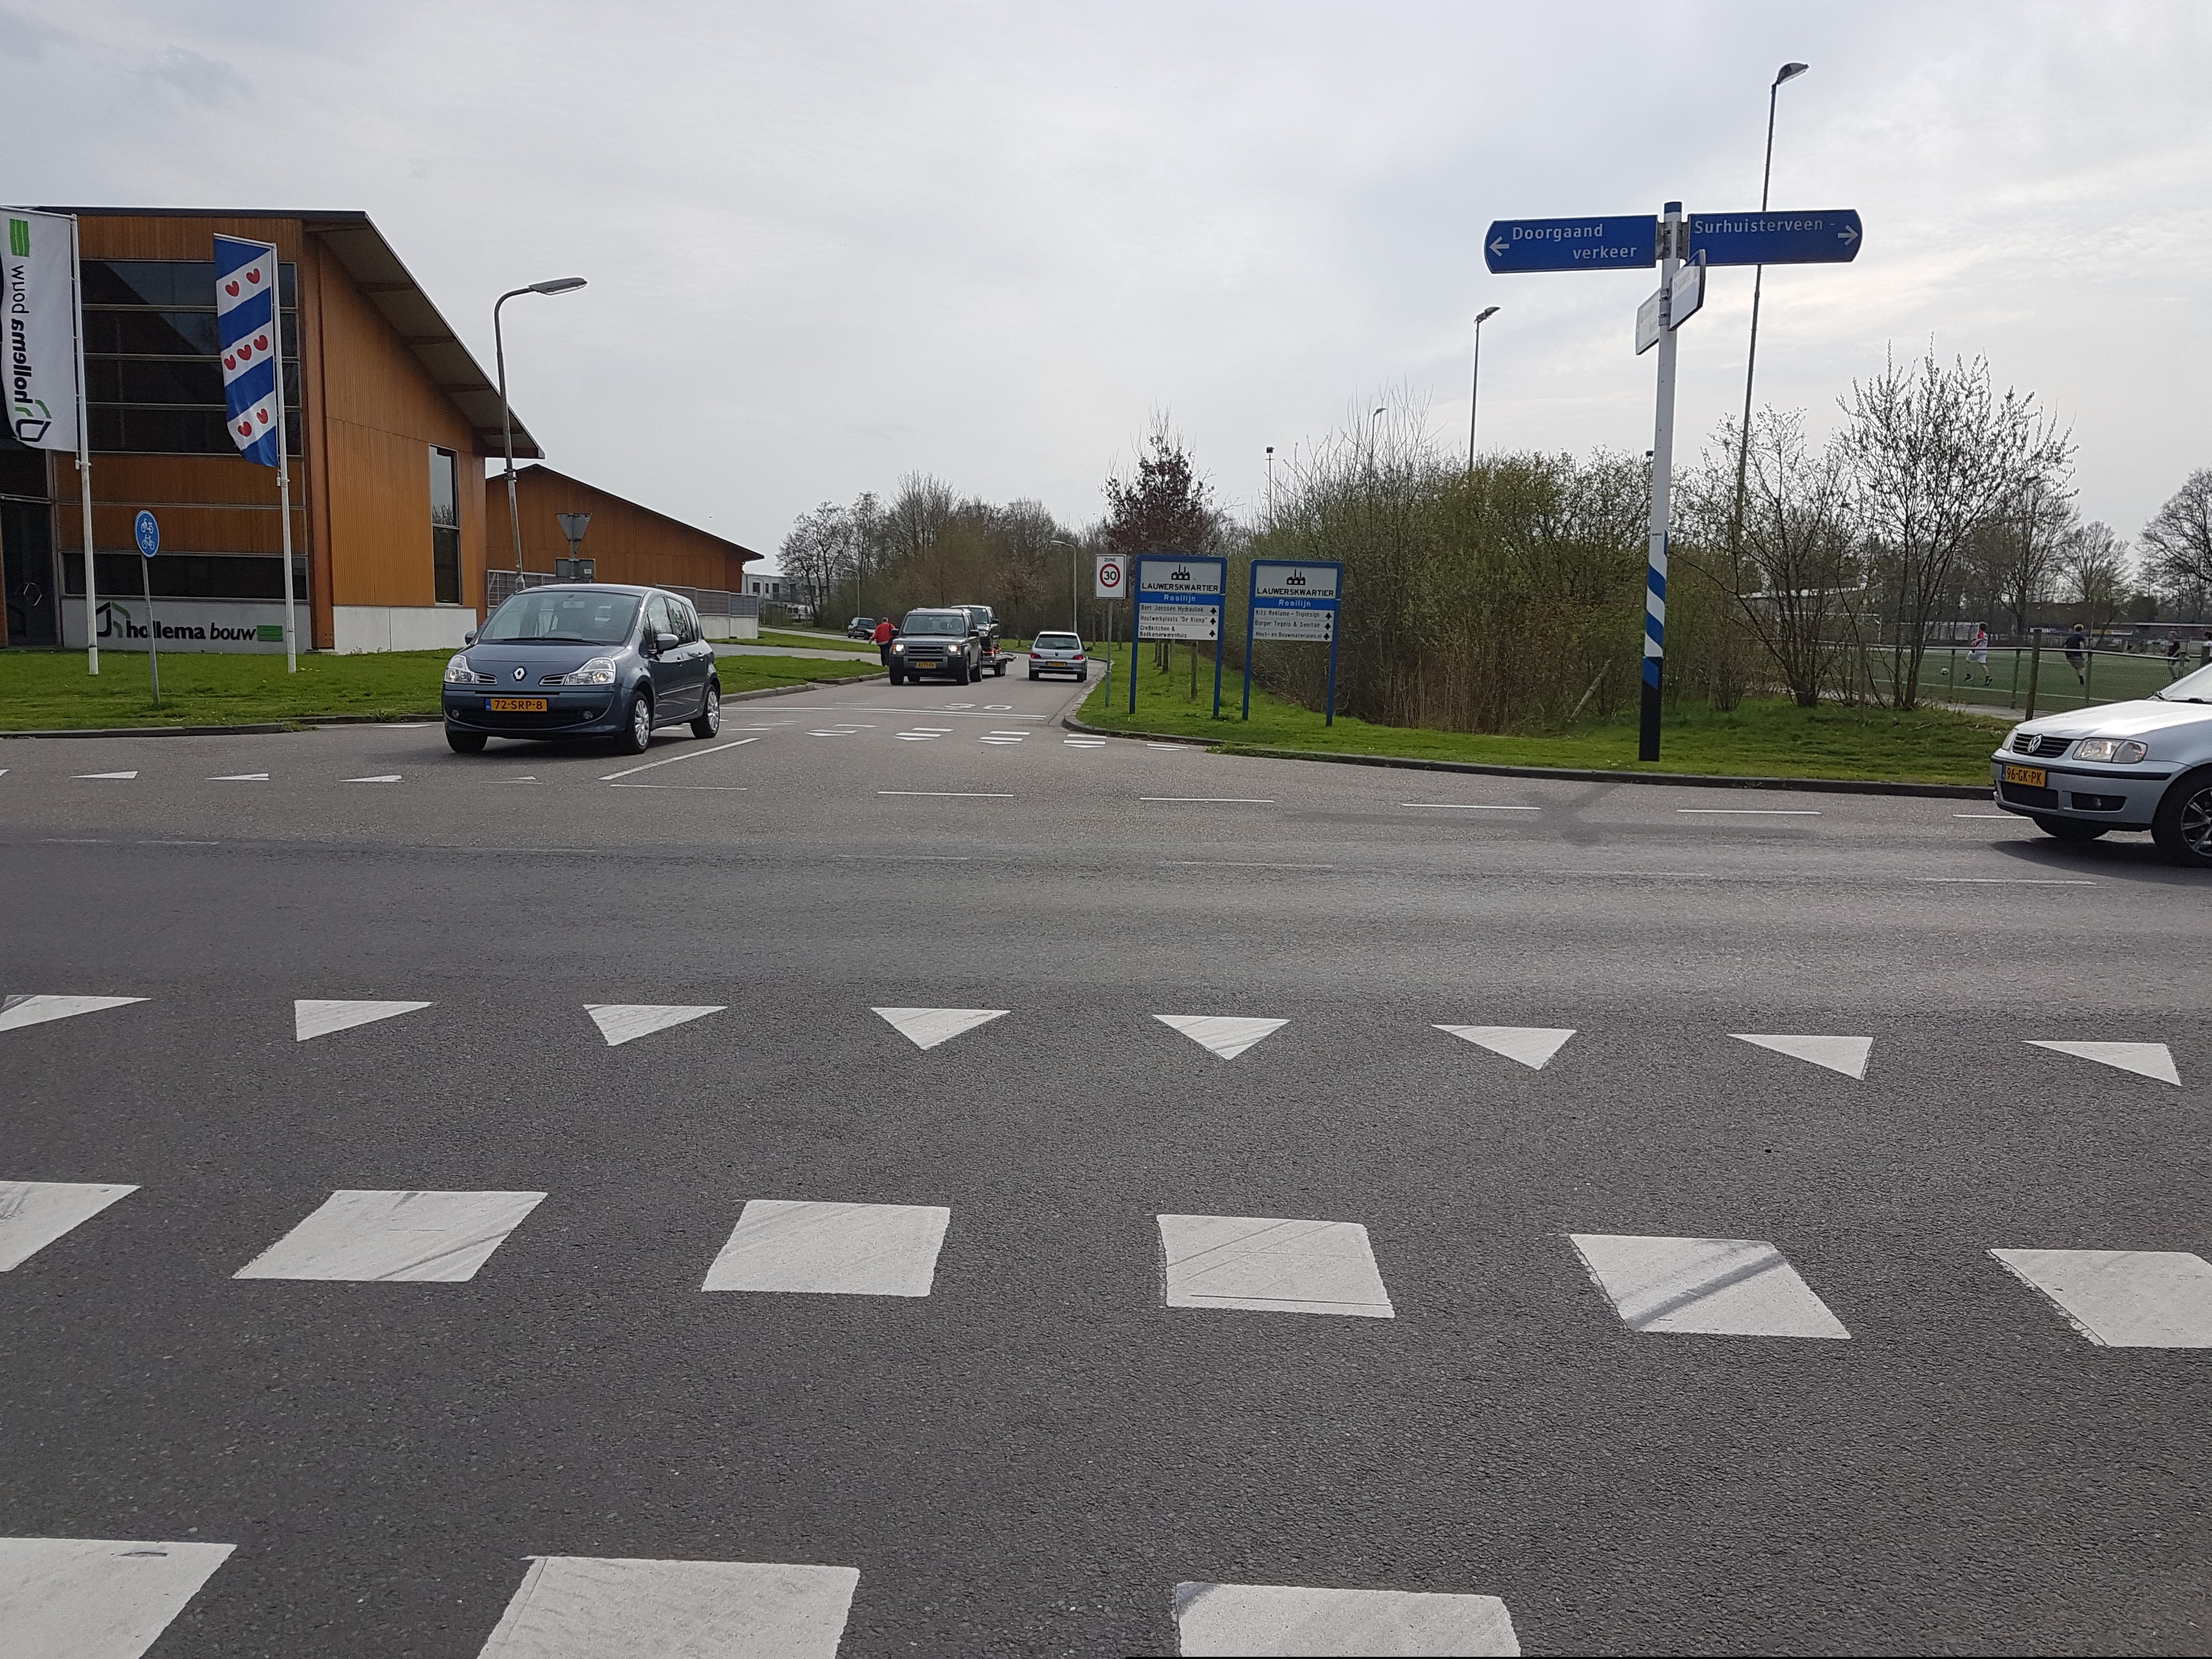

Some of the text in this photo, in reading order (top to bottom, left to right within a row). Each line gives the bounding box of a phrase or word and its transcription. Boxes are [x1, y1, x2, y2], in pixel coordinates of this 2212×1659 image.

[1694, 219, 1823, 234] Surhuisterveen
[1513, 224, 1603, 242] Doorgaand
[1572, 246, 1637, 260] verkeer
[1103, 571, 1117, 581] 30
[1142, 582, 1219, 592] LAUWERSKWARTIER
[1257, 587, 1334, 597] LAUWERSKWARTIER
[1164, 594, 1196, 603] Rooilijn
[1279, 599, 1311, 608] Rooilijn
[210, 622, 257, 641] bouw
[494, 700, 543, 710] 72-SRP-8
[2007, 767, 2042, 784] 96-GK-PK
